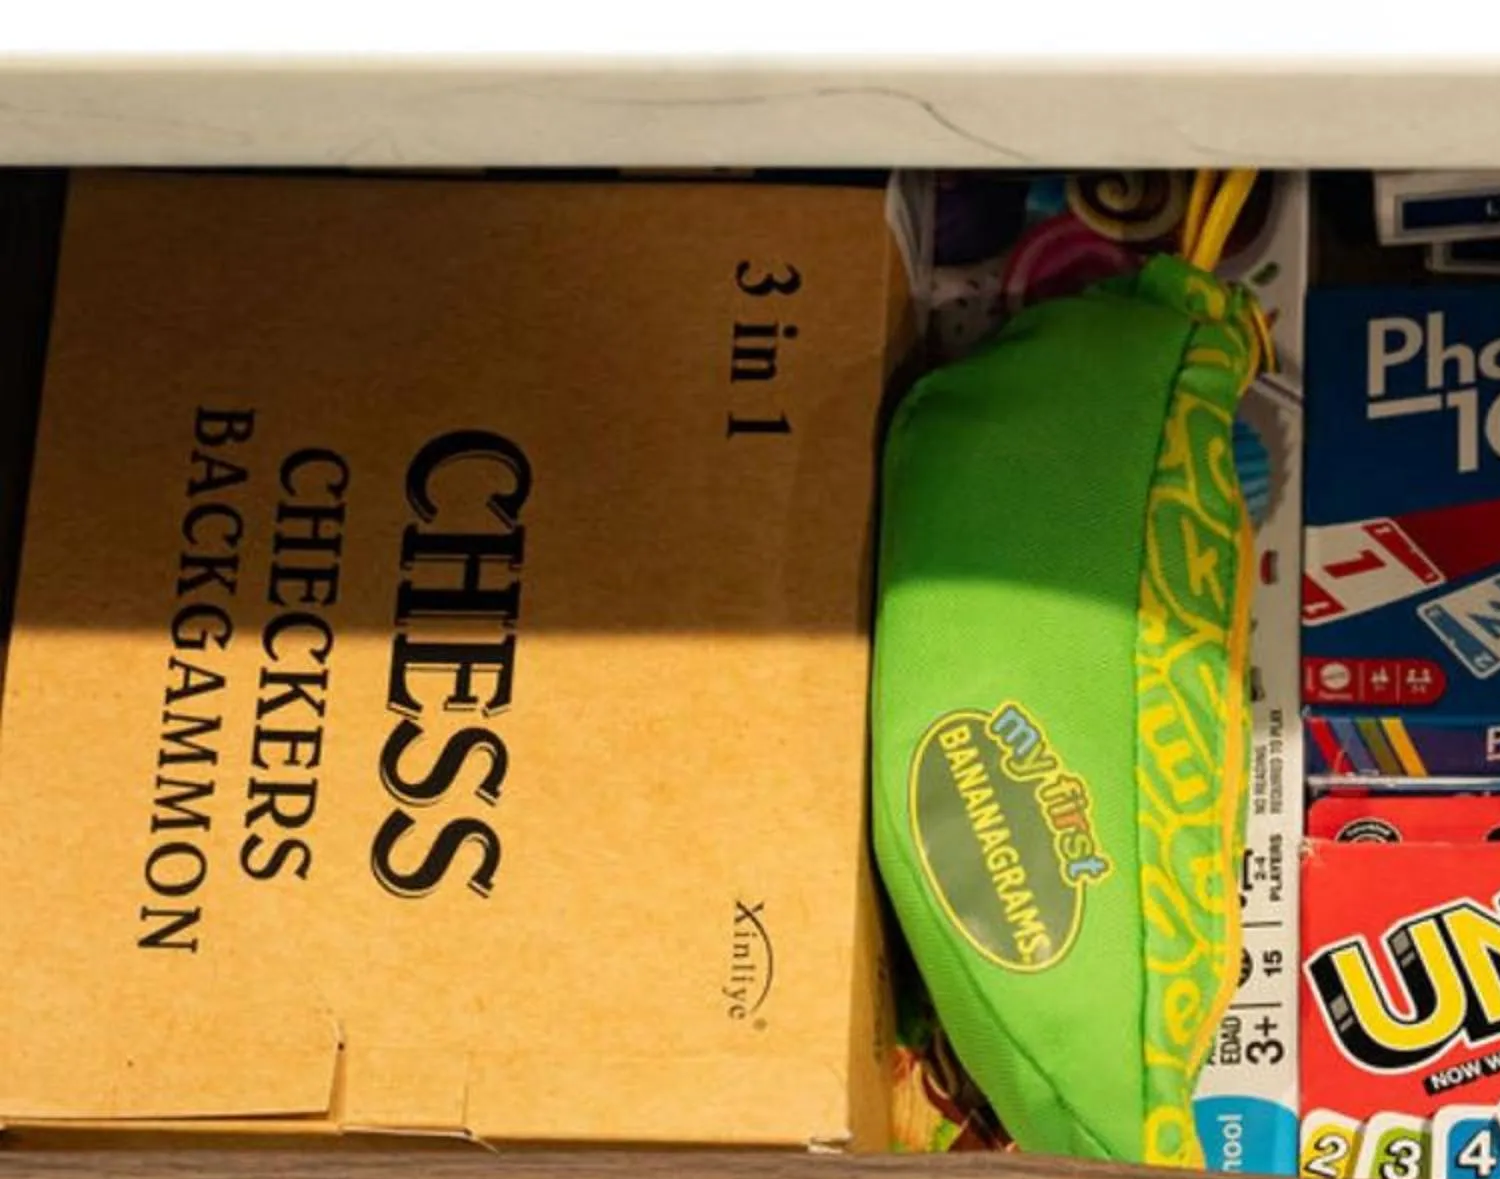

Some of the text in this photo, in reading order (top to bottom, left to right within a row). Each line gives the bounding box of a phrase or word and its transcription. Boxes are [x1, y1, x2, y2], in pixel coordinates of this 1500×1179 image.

[725, 260, 802, 440] 3 in 1
[1323, 548, 1387, 580] 1
[138, 406, 256, 953] BACKGAMMON
[238, 447, 351, 882] CHECKERS
[370, 428, 533, 899] CHESS
[989, 705, 1060, 780] my
[1038, 771, 1107, 881] first
[1269, 833, 1283, 902] PLAYERS
[1262, 950, 1284, 977] 15
[1219, 1015, 1243, 1066] EDAD
[1245, 1015, 1285, 1066] 3+
[1430, 1061, 1484, 1090] NOW
[1305, 1135, 1348, 1179] 2
[1458, 1129, 1498, 1177] 4
